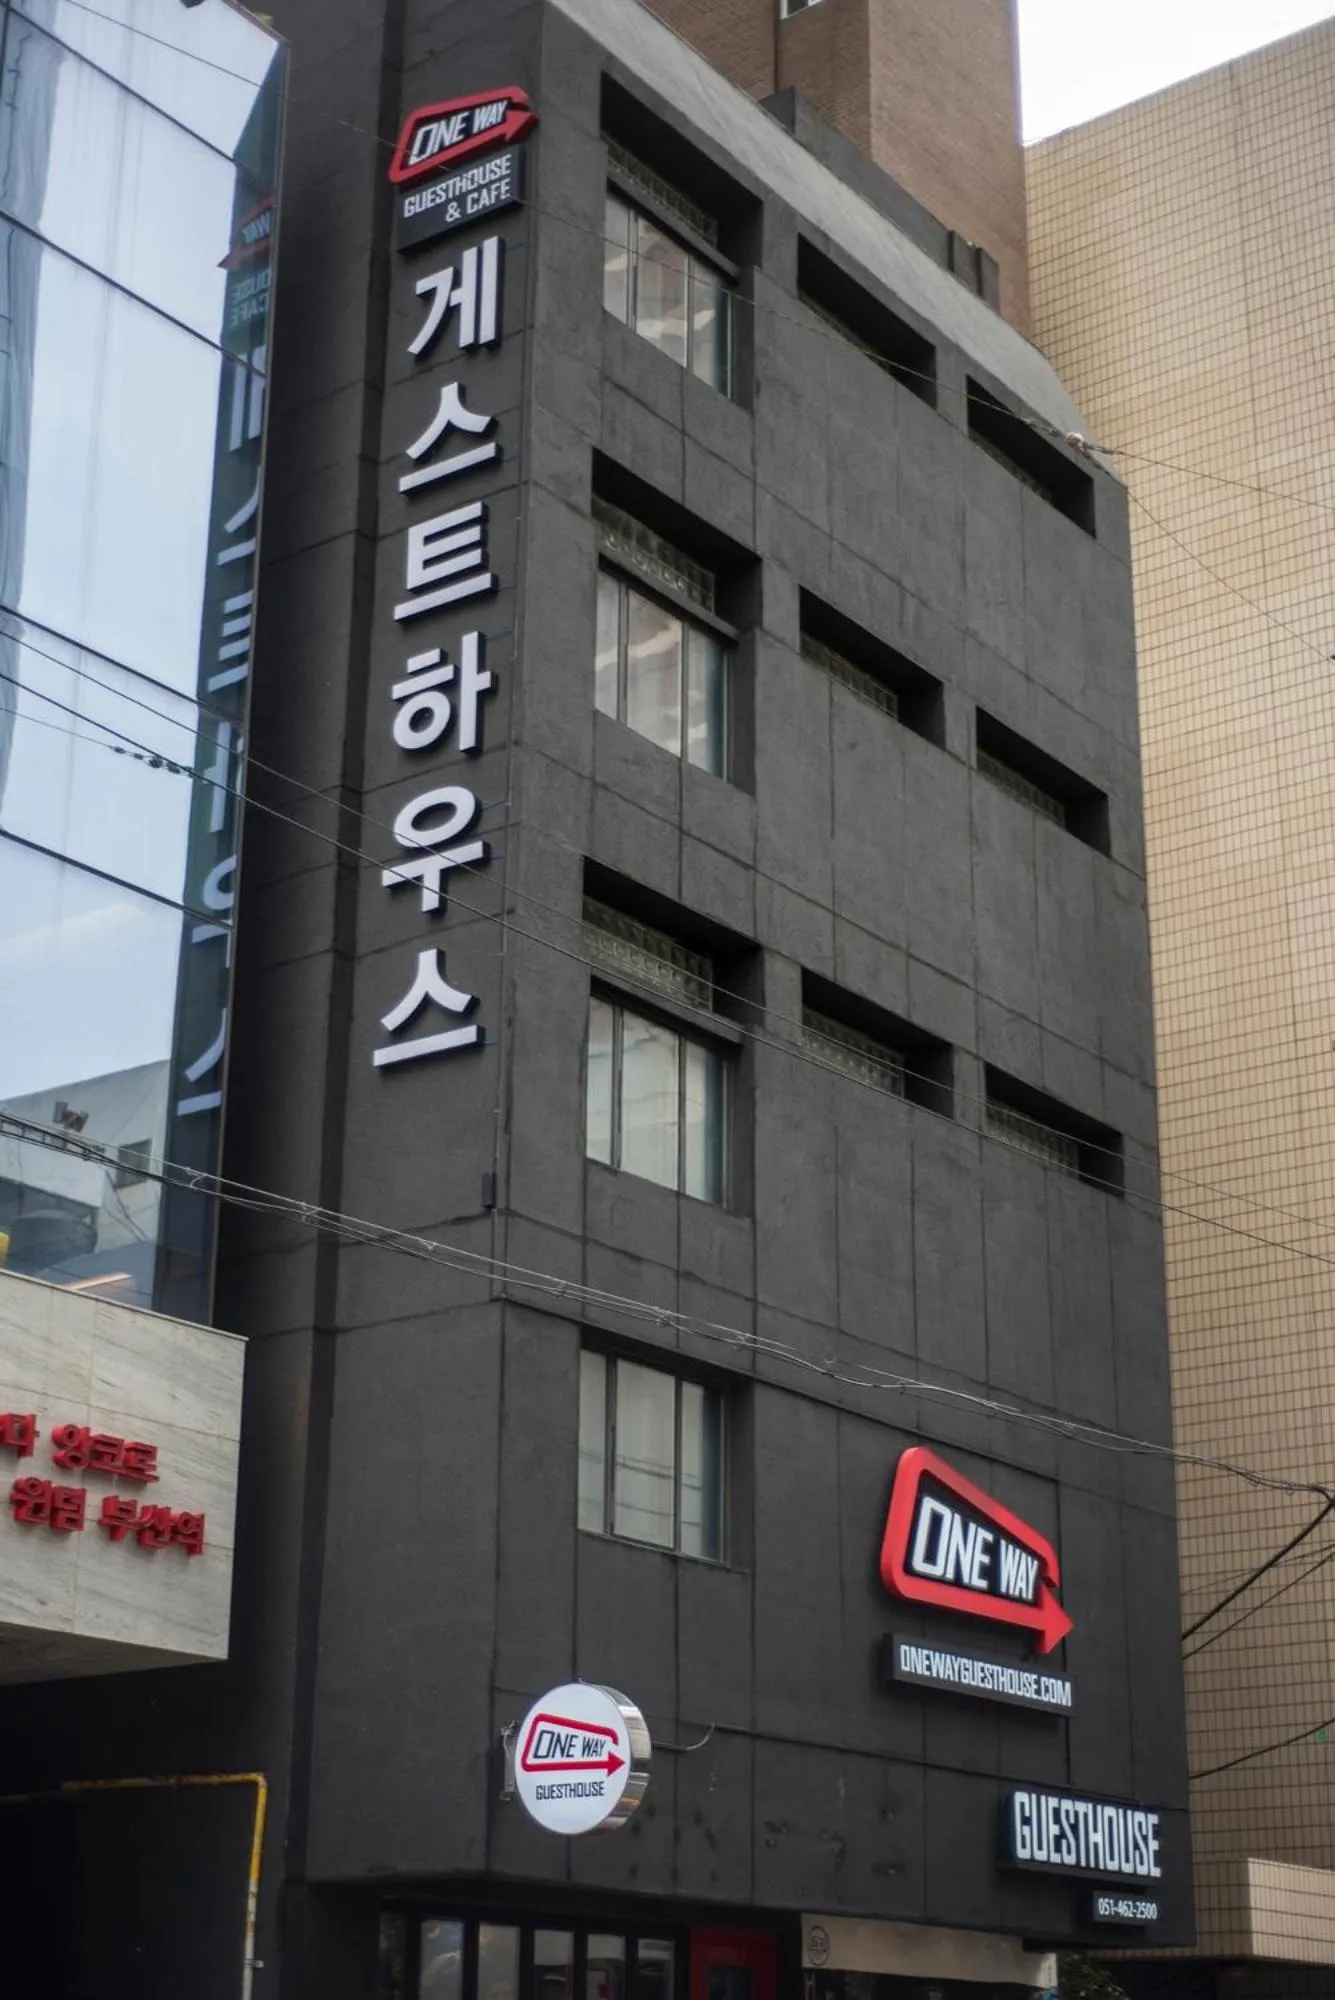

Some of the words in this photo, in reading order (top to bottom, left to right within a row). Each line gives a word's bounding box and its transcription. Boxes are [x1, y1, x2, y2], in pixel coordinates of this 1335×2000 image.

[407, 111, 467, 165] ONE
[471, 101, 508, 132] WAY
[404, 154, 512, 218] GUESTHOUSE
[446, 202, 461, 222] &
[466, 178, 512, 214] CAFE
[373, 235, 499, 1067] 게스트하우스
[97, 1495, 205, 1557] 부산역
[911, 1496, 993, 1588] ONE
[999, 1539, 1040, 1600] WAY
[900, 1644, 1072, 1707] ONEWAYGUESTHOUSE.COM
[533, 1730, 579, 1759] ONE
[581, 1736, 606, 1757] WAY
[536, 1781, 605, 1800] GUESTHOUSE
[1014, 1791, 1161, 1877] GUESTHOUSE
[1098, 1897, 1157, 1920] 051-462-2500
